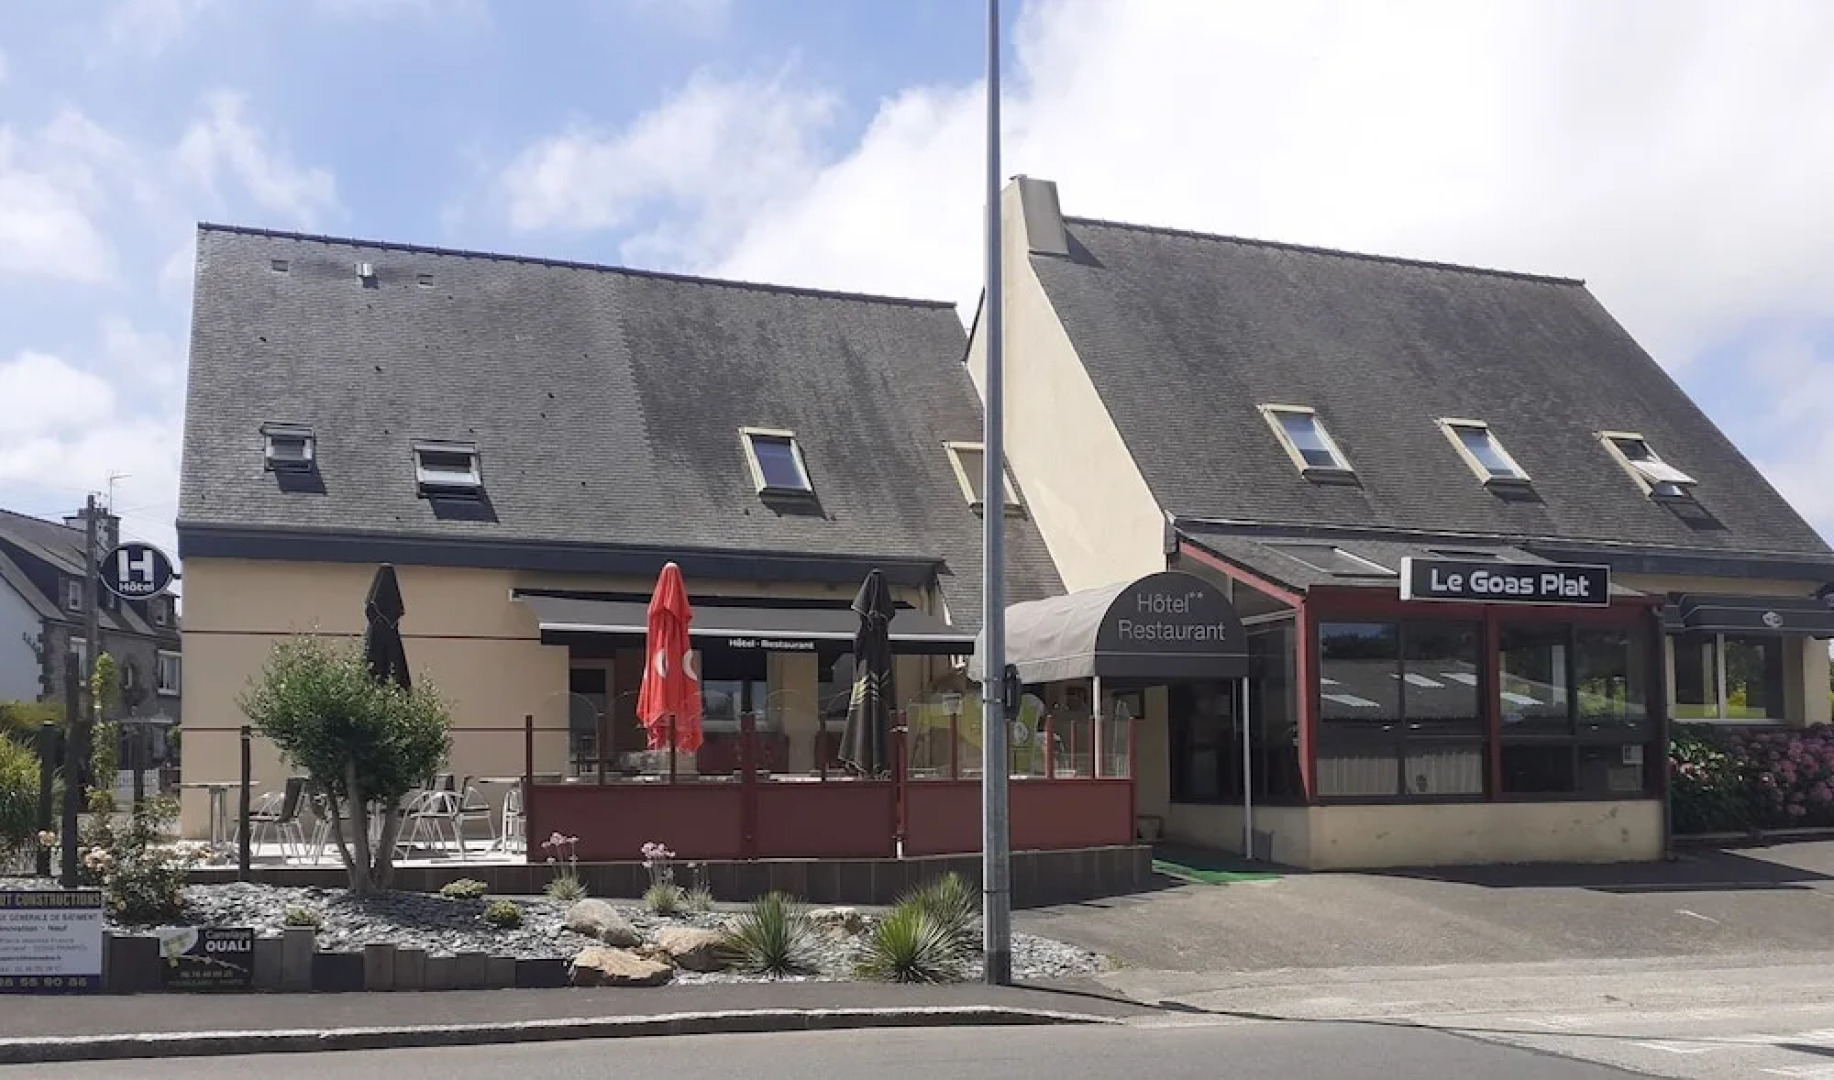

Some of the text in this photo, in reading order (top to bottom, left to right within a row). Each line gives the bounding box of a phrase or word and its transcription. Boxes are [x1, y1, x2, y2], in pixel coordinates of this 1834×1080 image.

[118, 550, 154, 581] H
[118, 581, 155, 592] Hôtel
[1431, 568, 1589, 597] Le Goas Plat
[1118, 620, 1226, 640] Restaurant
[761, 640, 815, 650] Restaurant
[16, 893, 101, 907] CONSTRUCTIONS
